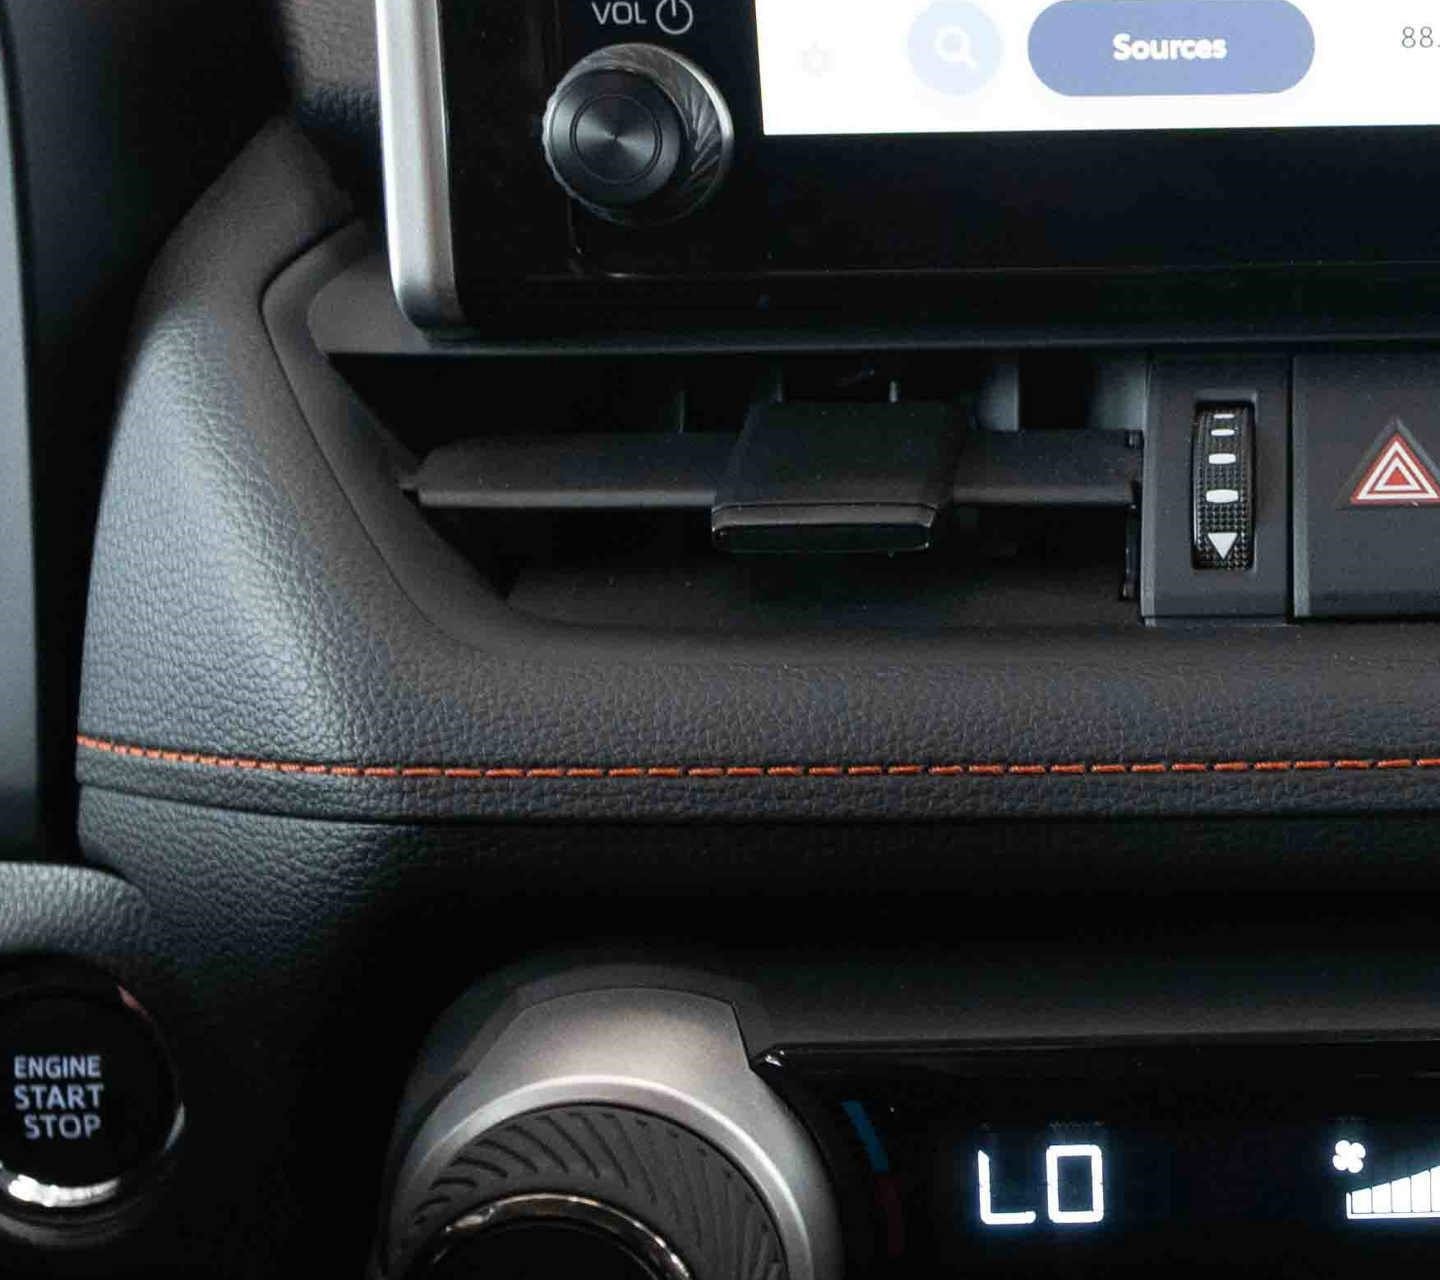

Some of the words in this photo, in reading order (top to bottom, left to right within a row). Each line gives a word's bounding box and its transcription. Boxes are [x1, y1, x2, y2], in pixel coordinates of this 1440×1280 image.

[591, 0, 648, 26] VOL
[1112, 33, 1228, 61] Sources
[13, 1054, 102, 1080] ENGINE
[13, 1083, 104, 1110] START
[23, 1113, 102, 1140] STOP
[977, 1143, 1105, 1226] LO
